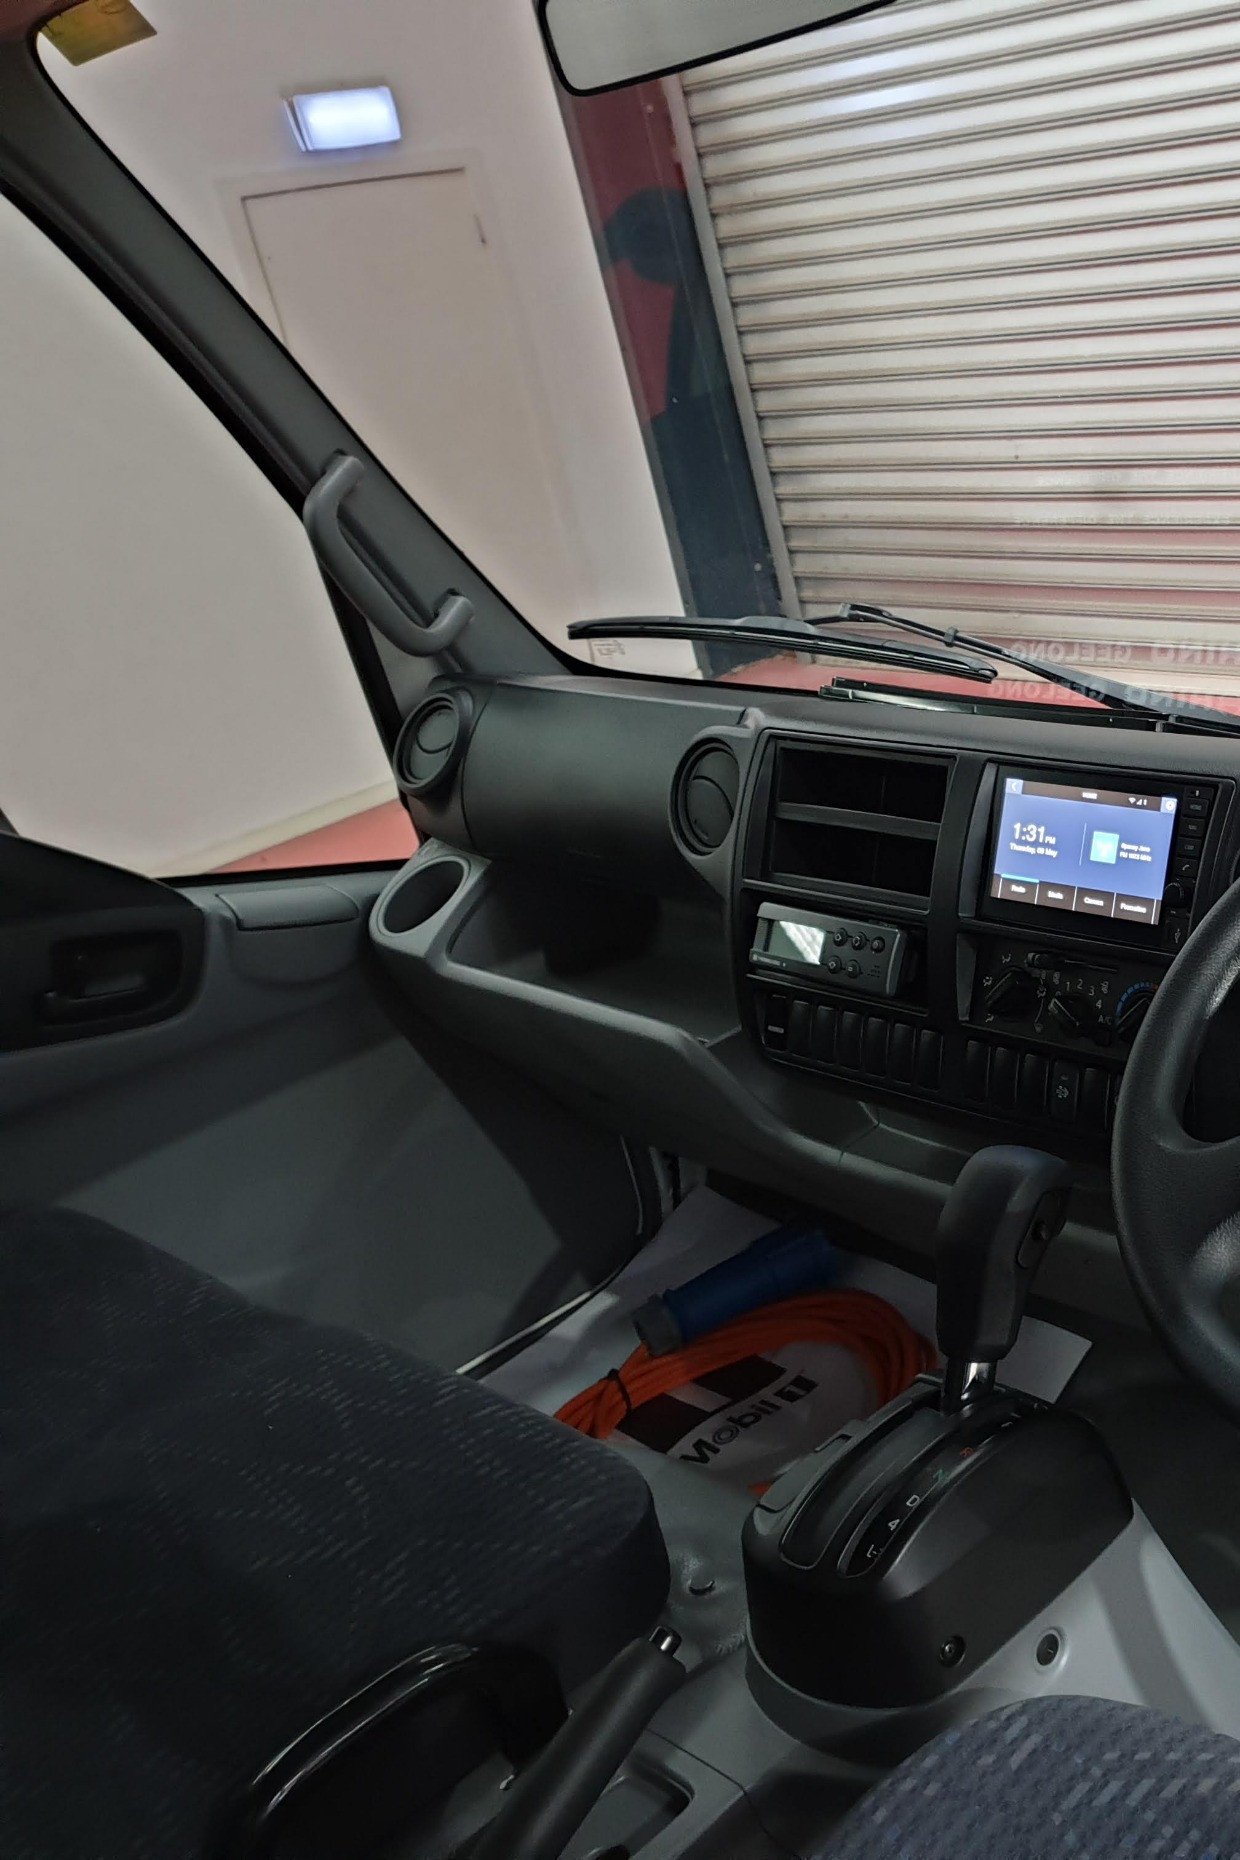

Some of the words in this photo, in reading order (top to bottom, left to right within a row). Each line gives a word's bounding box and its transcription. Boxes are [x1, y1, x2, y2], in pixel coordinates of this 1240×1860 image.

[1013, 822, 1045, 843] 1:31
[679, 1398, 783, 1464] Mobil
[906, 1494, 920, 1507] D
